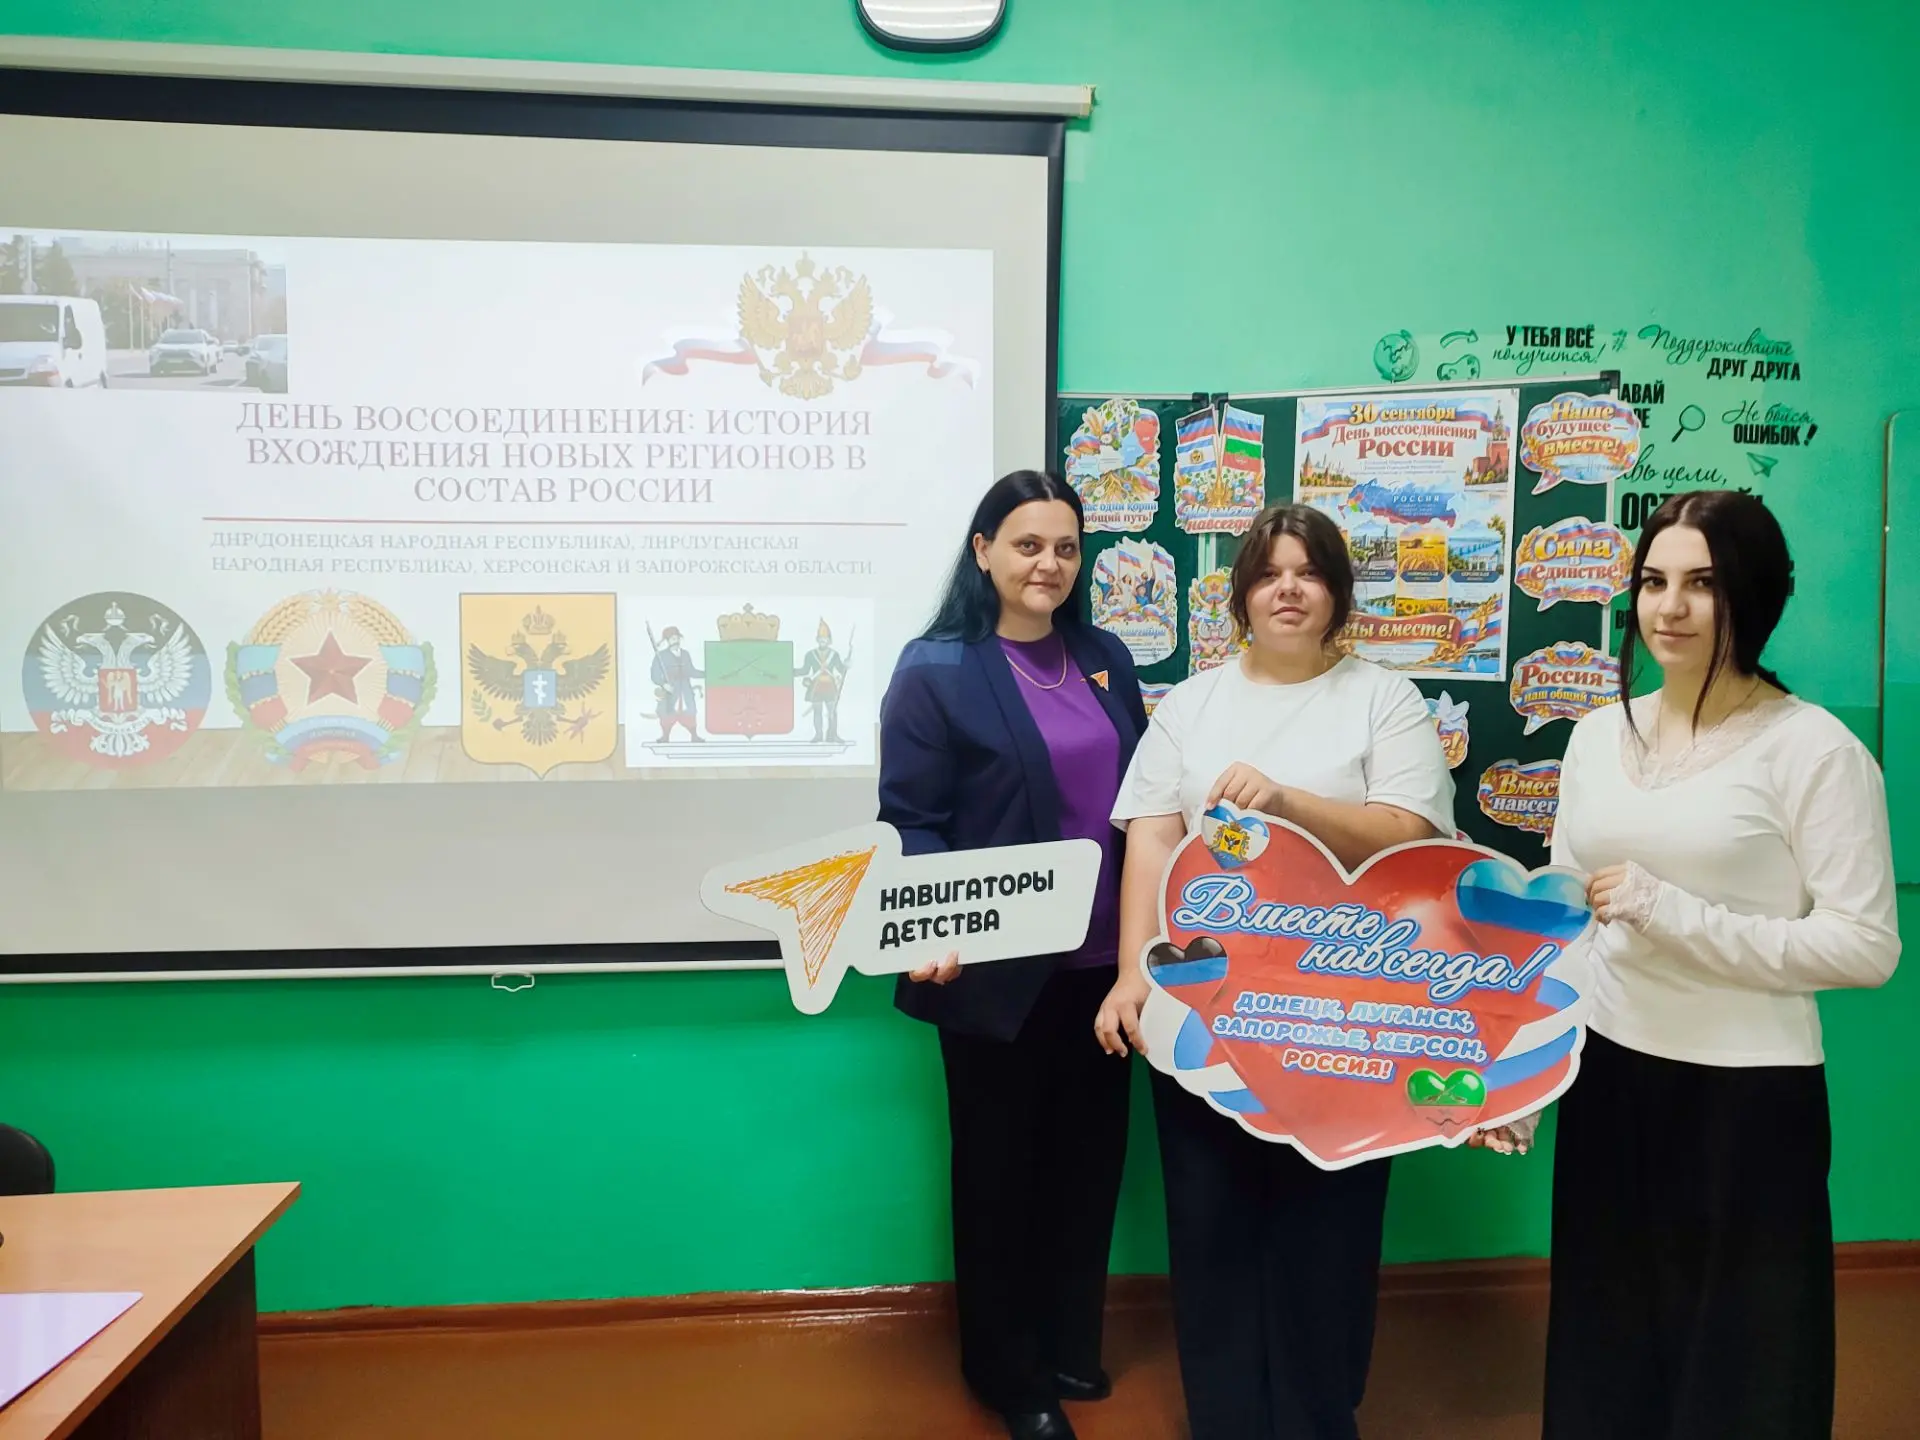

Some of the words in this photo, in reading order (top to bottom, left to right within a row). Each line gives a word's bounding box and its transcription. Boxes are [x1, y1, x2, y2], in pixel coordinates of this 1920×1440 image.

[1506, 325, 1516, 346] У
[1522, 326, 1561, 347] ТЕБЯ
[1565, 324, 1595, 349] ВСЁ
[1493, 343, 1606, 376] получится!
[1707, 357, 1748, 380] ДРУГ
[1751, 360, 1801, 382] ДРУГА
[1620, 379, 1665, 404] АВАЙ
[236, 402, 343, 434] ДЕНЬ
[353, 405, 695, 438] ВОССОЕДИНЕНИЯ:
[706, 409, 872, 436] ИСТОРИЯ
[1349, 401, 1379, 425] 30
[1381, 402, 1457, 424] сентября
[1551, 399, 1616, 421] Наше
[1722, 400, 1760, 424] Не
[1332, 426, 1371, 447] День
[1374, 424, 1478, 441] воссоединения
[1536, 420, 1611, 439] будущее
[1733, 422, 1818, 446] ОШИБОК!
[247, 438, 490, 471] ВХОЖДЕНИЯ
[502, 442, 634, 469] НОВЫХ
[645, 443, 835, 470] РЕГИОНОВ
[845, 445, 867, 470] В
[1357, 439, 1456, 459] России
[1543, 439, 1619, 456] вместе!
[414, 477, 558, 503] СОСТАВ
[568, 478, 714, 503] РОССИИ
[380, 534, 488, 551] НАРОДНАЯ
[1534, 534, 1615, 560] Сила
[211, 556, 324, 573] НАРОДНАЯ
[483, 559, 611, 575] ХЕРСОНСКАЯ
[617, 560, 631, 574] И
[636, 560, 779, 575] ЗАПОРОЖСКАЯ
[1530, 562, 1626, 580] единстве!
[1379, 619, 1456, 639] вместе!
[1520, 664, 1604, 688] Россия
[1524, 690, 1549, 702] наш
[1550, 688, 1588, 702] общий
[879, 869, 1055, 912] НАВИГАТОРЫ
[1174, 874, 1386, 941] Вместе
[879, 908, 1001, 950] ДЕТСТВА
[1297, 917, 1560, 1002] навсегда!
[1233, 991, 1345, 1022] ДОНЕЦК,
[1348, 1000, 1477, 1033] ЛУГАНСК,
[1212, 1014, 1371, 1051] ЗАПОРОЖЬЕ,
[1374, 1032, 1488, 1063] ХЕРСОН,
[1283, 1049, 1393, 1079] РОССИЯ!
